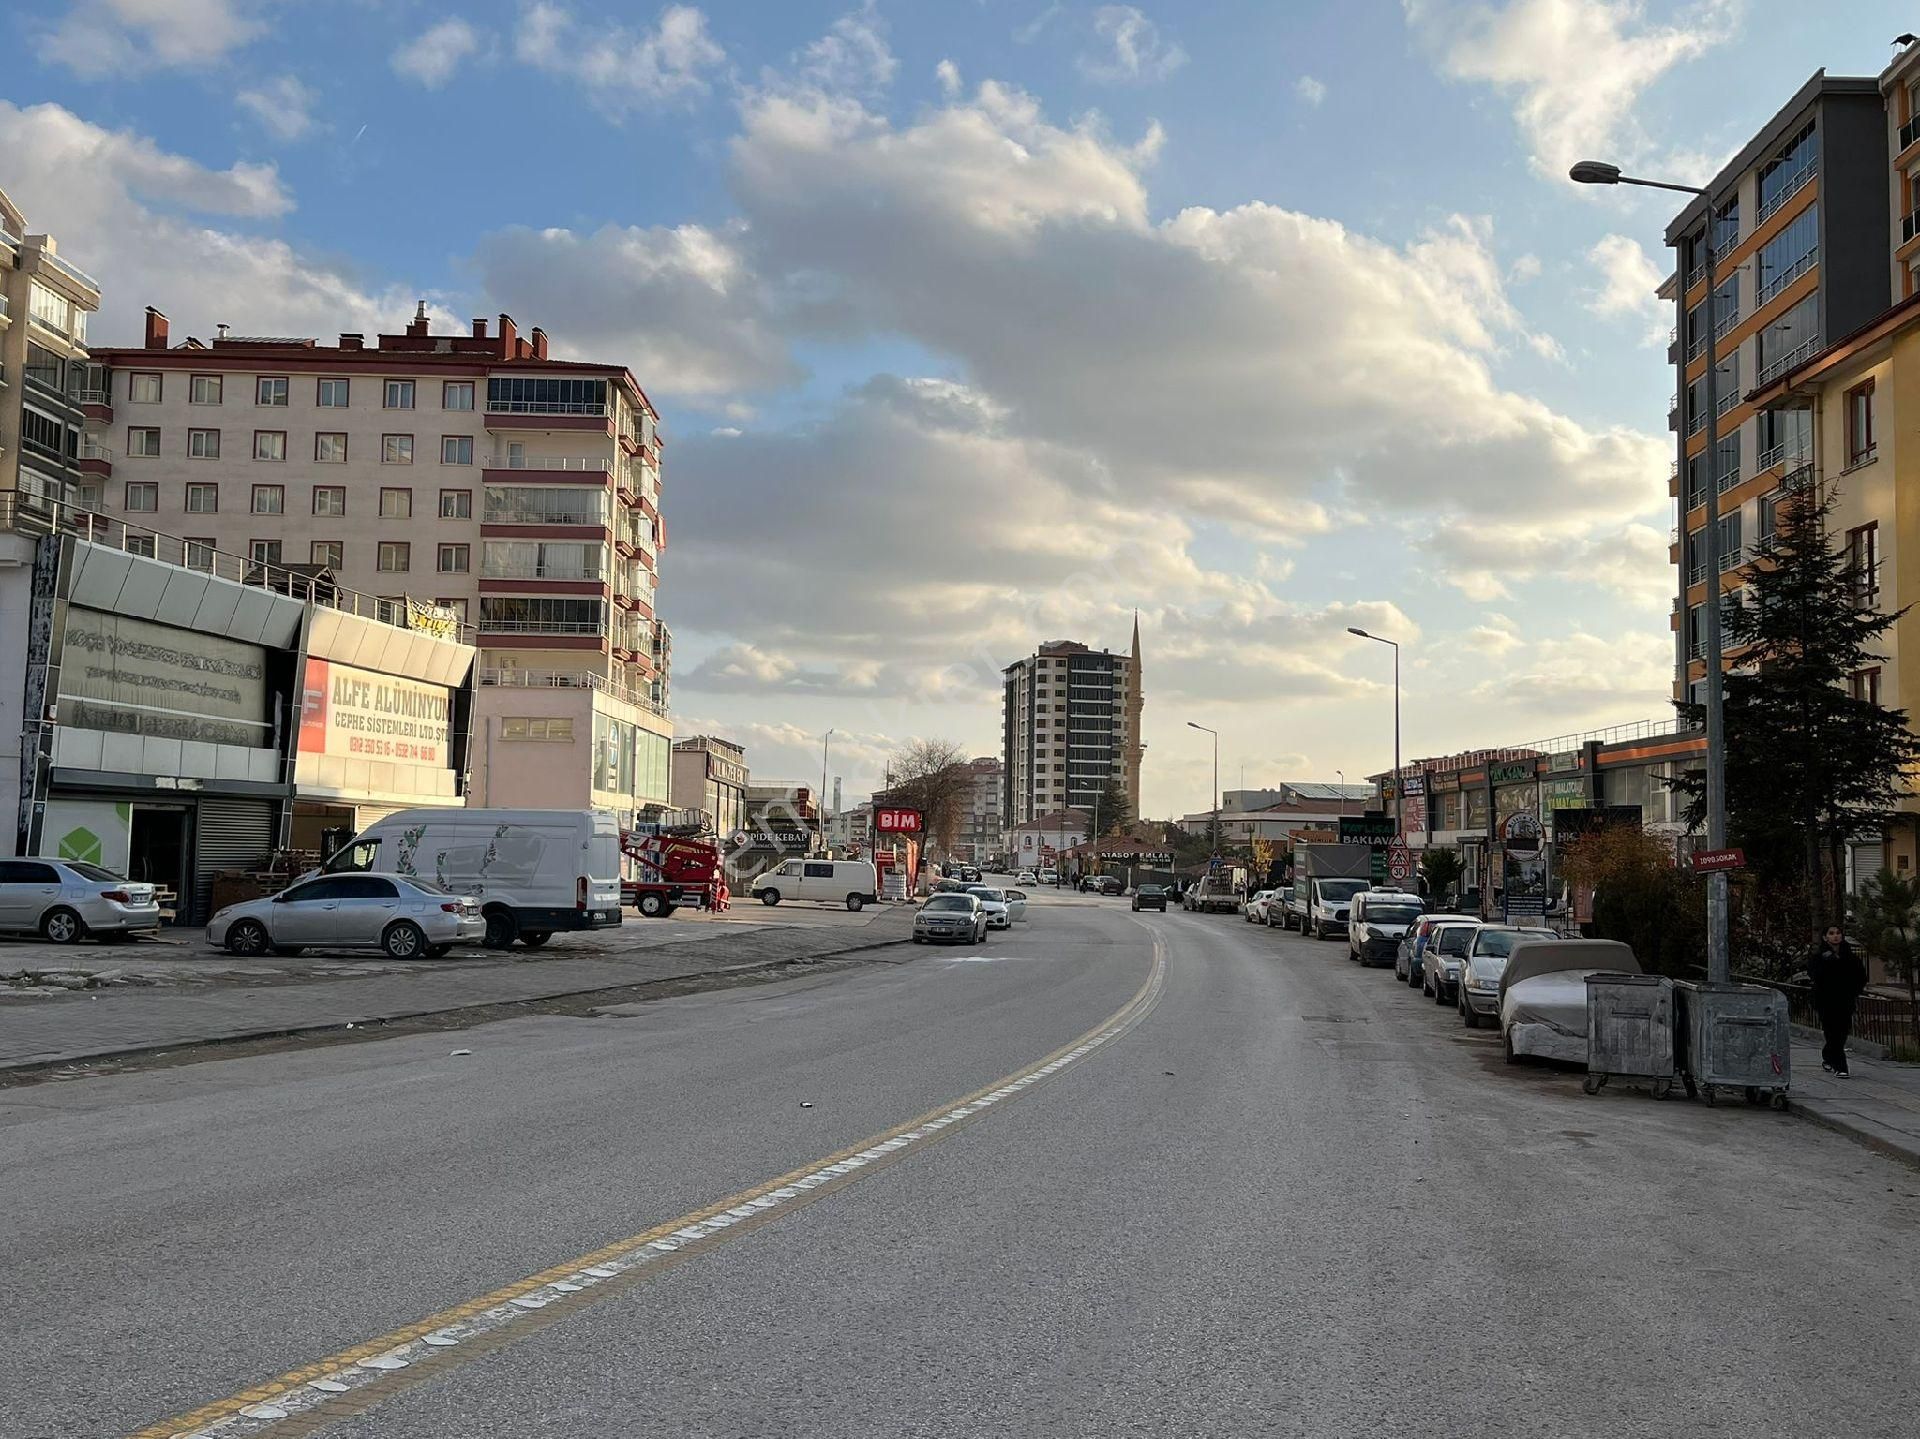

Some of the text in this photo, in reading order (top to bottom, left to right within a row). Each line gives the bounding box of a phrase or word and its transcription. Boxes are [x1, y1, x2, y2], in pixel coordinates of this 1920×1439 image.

[332, 676, 453, 722] ALFE ALÜMİNYUM
[335, 711, 365, 732] CEPHE
[366, 714, 418, 738] SİSTEMLERİ
[881, 810, 915, 828] BİM
[750, 831, 808, 842] PİDE KEBAP
[1393, 867, 1404, 877] 30
